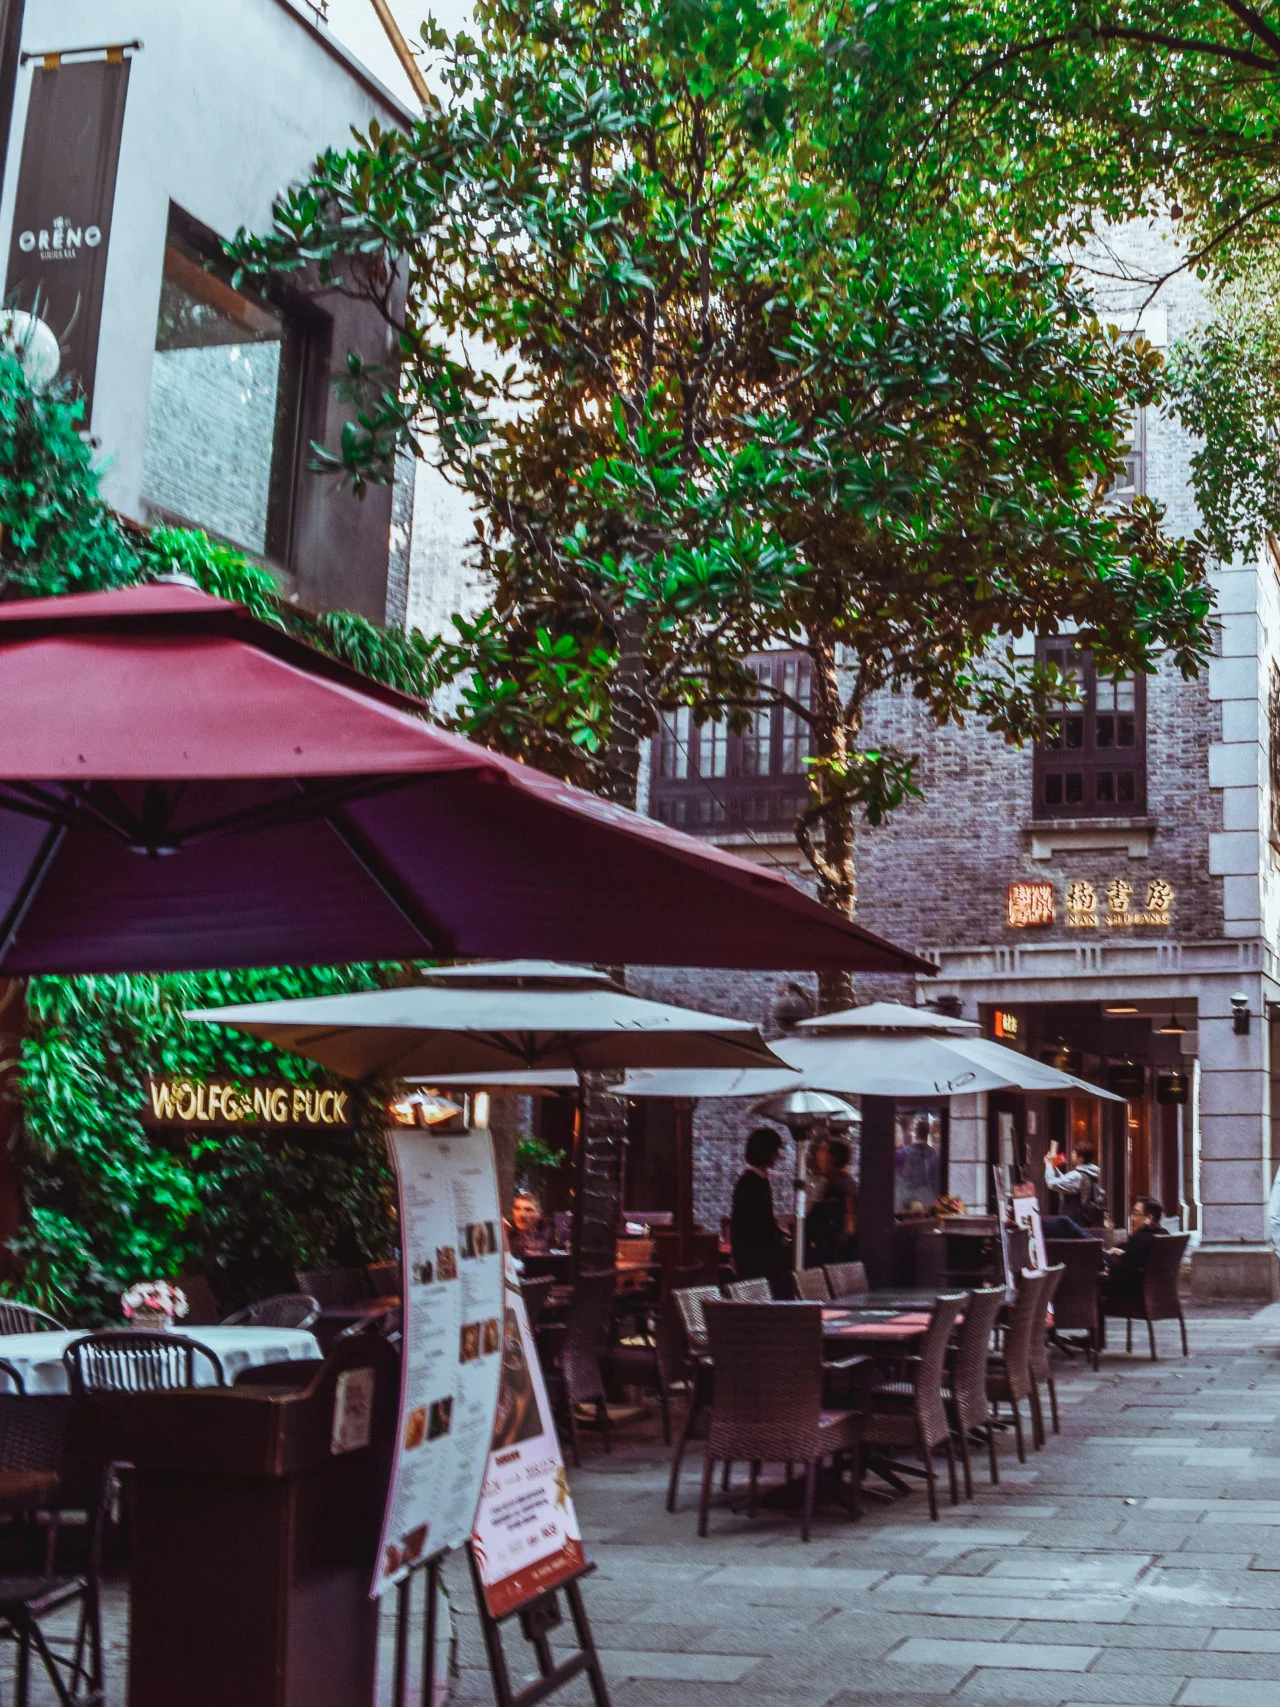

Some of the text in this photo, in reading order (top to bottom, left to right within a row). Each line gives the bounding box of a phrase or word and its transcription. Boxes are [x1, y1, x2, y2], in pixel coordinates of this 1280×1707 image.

[19, 225, 101, 252] ORENO
[1067, 913, 1098, 926] NAN
[293, 1088, 348, 1124] PUCK
